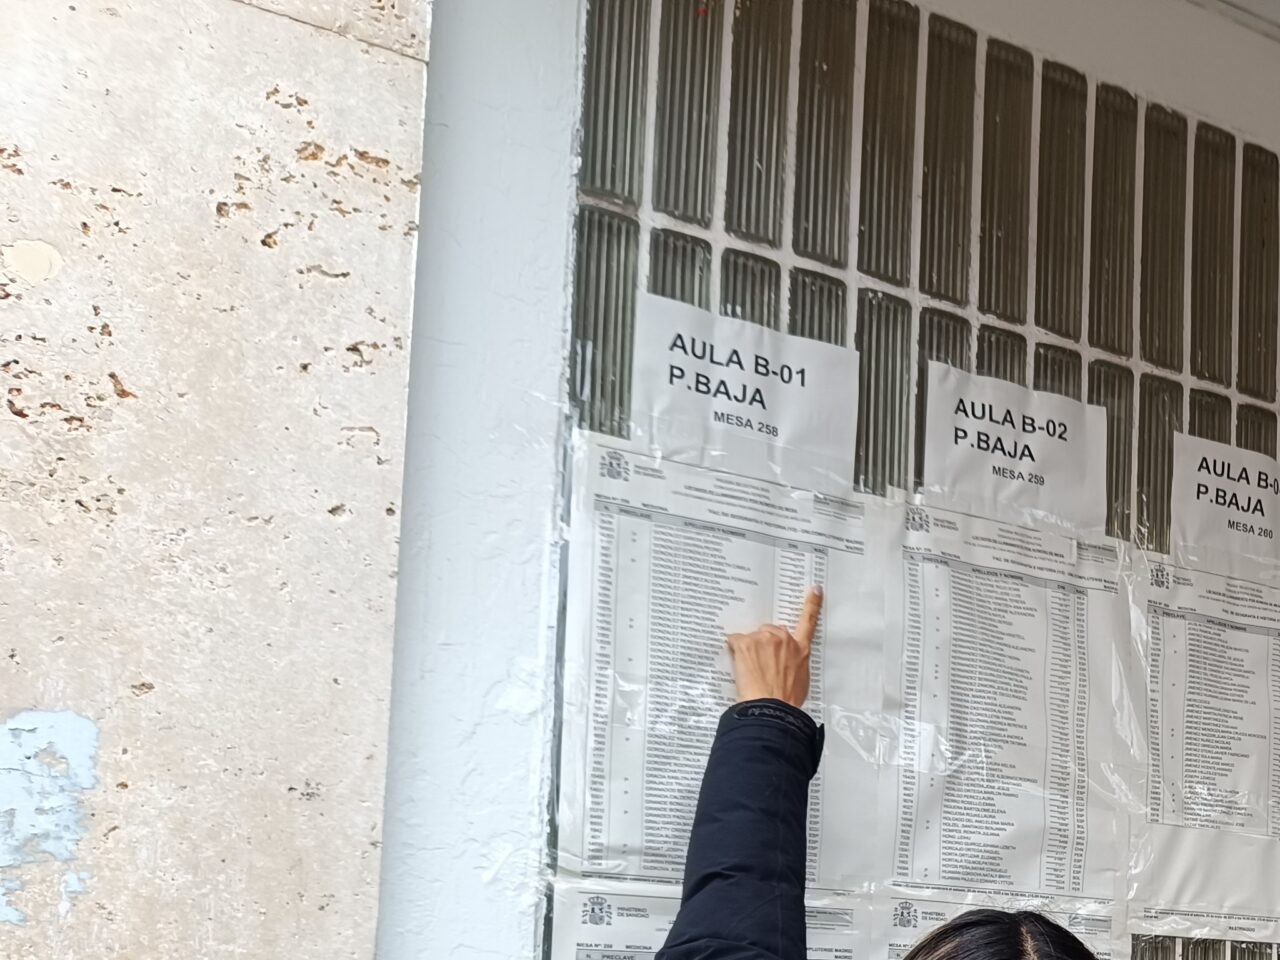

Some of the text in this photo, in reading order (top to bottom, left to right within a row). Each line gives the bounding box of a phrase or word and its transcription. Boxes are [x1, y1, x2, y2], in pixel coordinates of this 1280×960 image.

[669, 332, 808, 388] AULA B-01
[669, 364, 767, 411] P.BAJA
[713, 411, 779, 438] MESA 258
[953, 397, 1068, 443] AULA B-02
[953, 427, 1035, 463] P.BAJA
[992, 465, 1045, 487] MESA 259
[1197, 456, 1250, 486] AULA
[1196, 482, 1265, 517] P.BAJA
[1228, 519, 1273, 540] MESA 260
